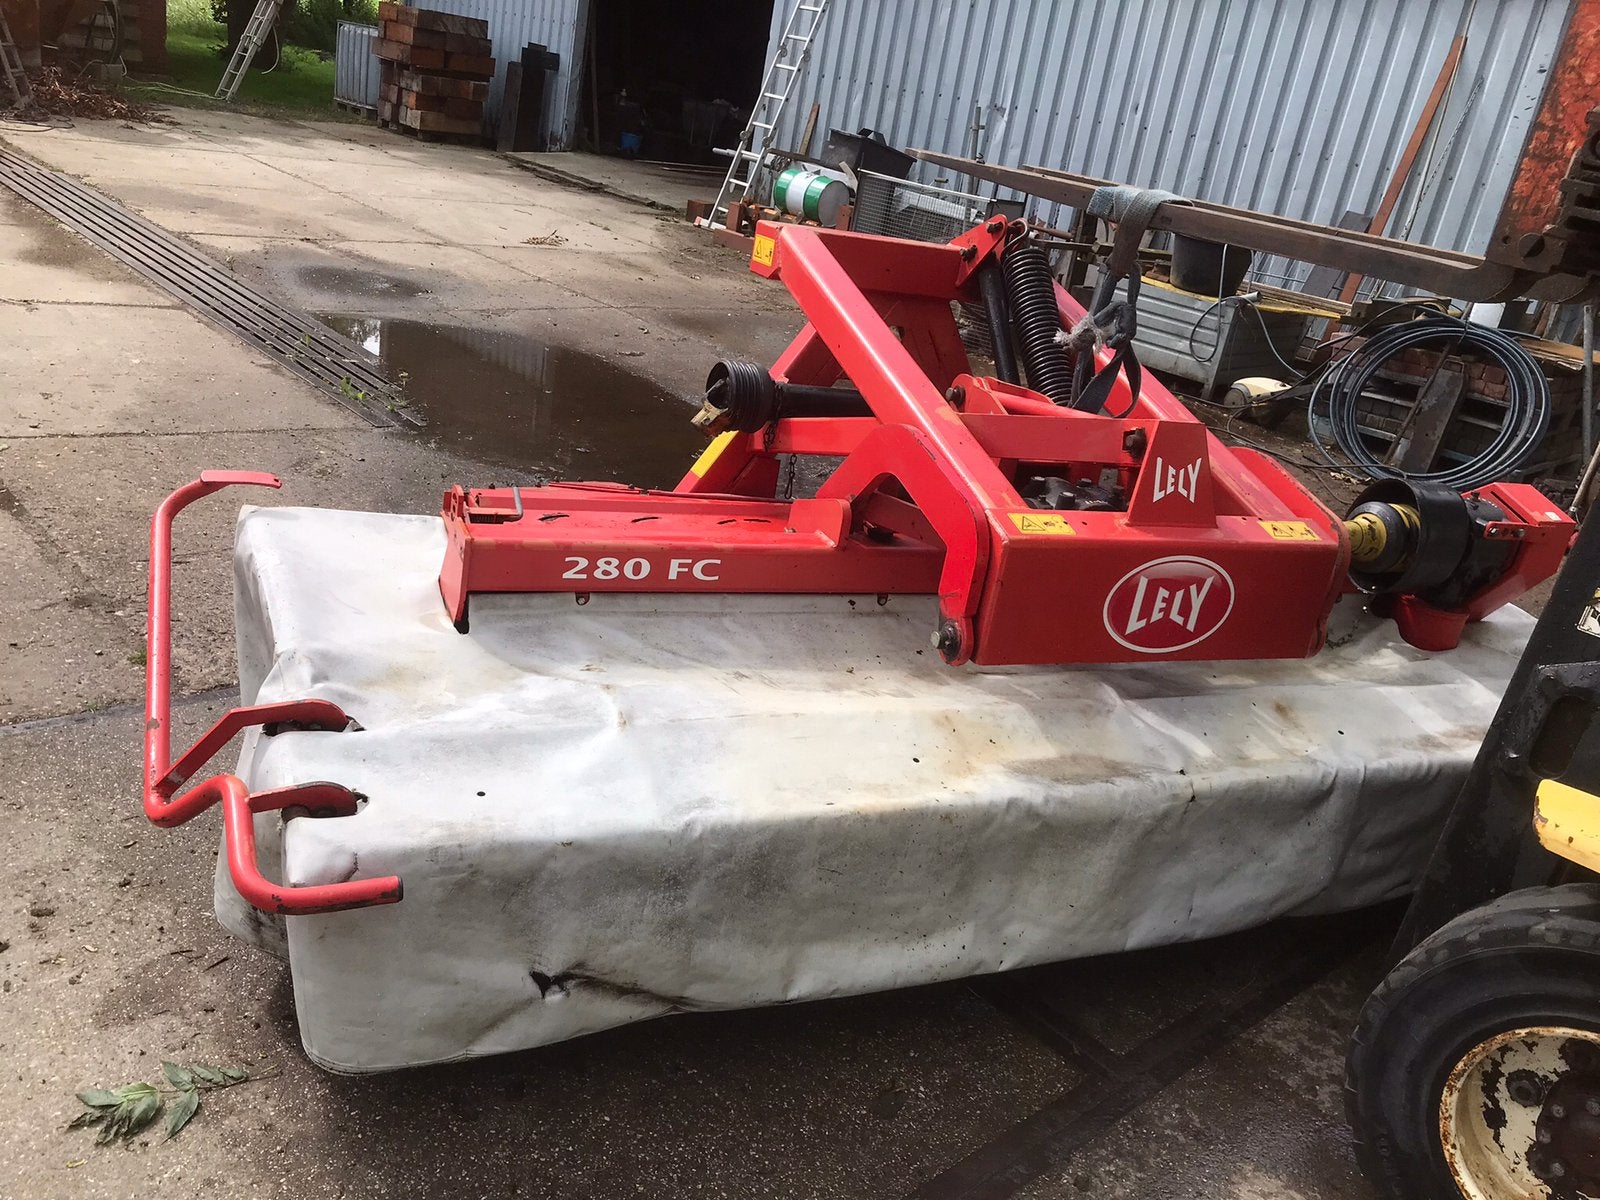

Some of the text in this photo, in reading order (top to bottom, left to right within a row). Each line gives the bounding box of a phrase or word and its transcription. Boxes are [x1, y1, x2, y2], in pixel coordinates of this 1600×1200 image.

[1152, 457, 1202, 504] LELY
[562, 556, 722, 582] 280 FC
[1125, 575, 1215, 635] LELY
